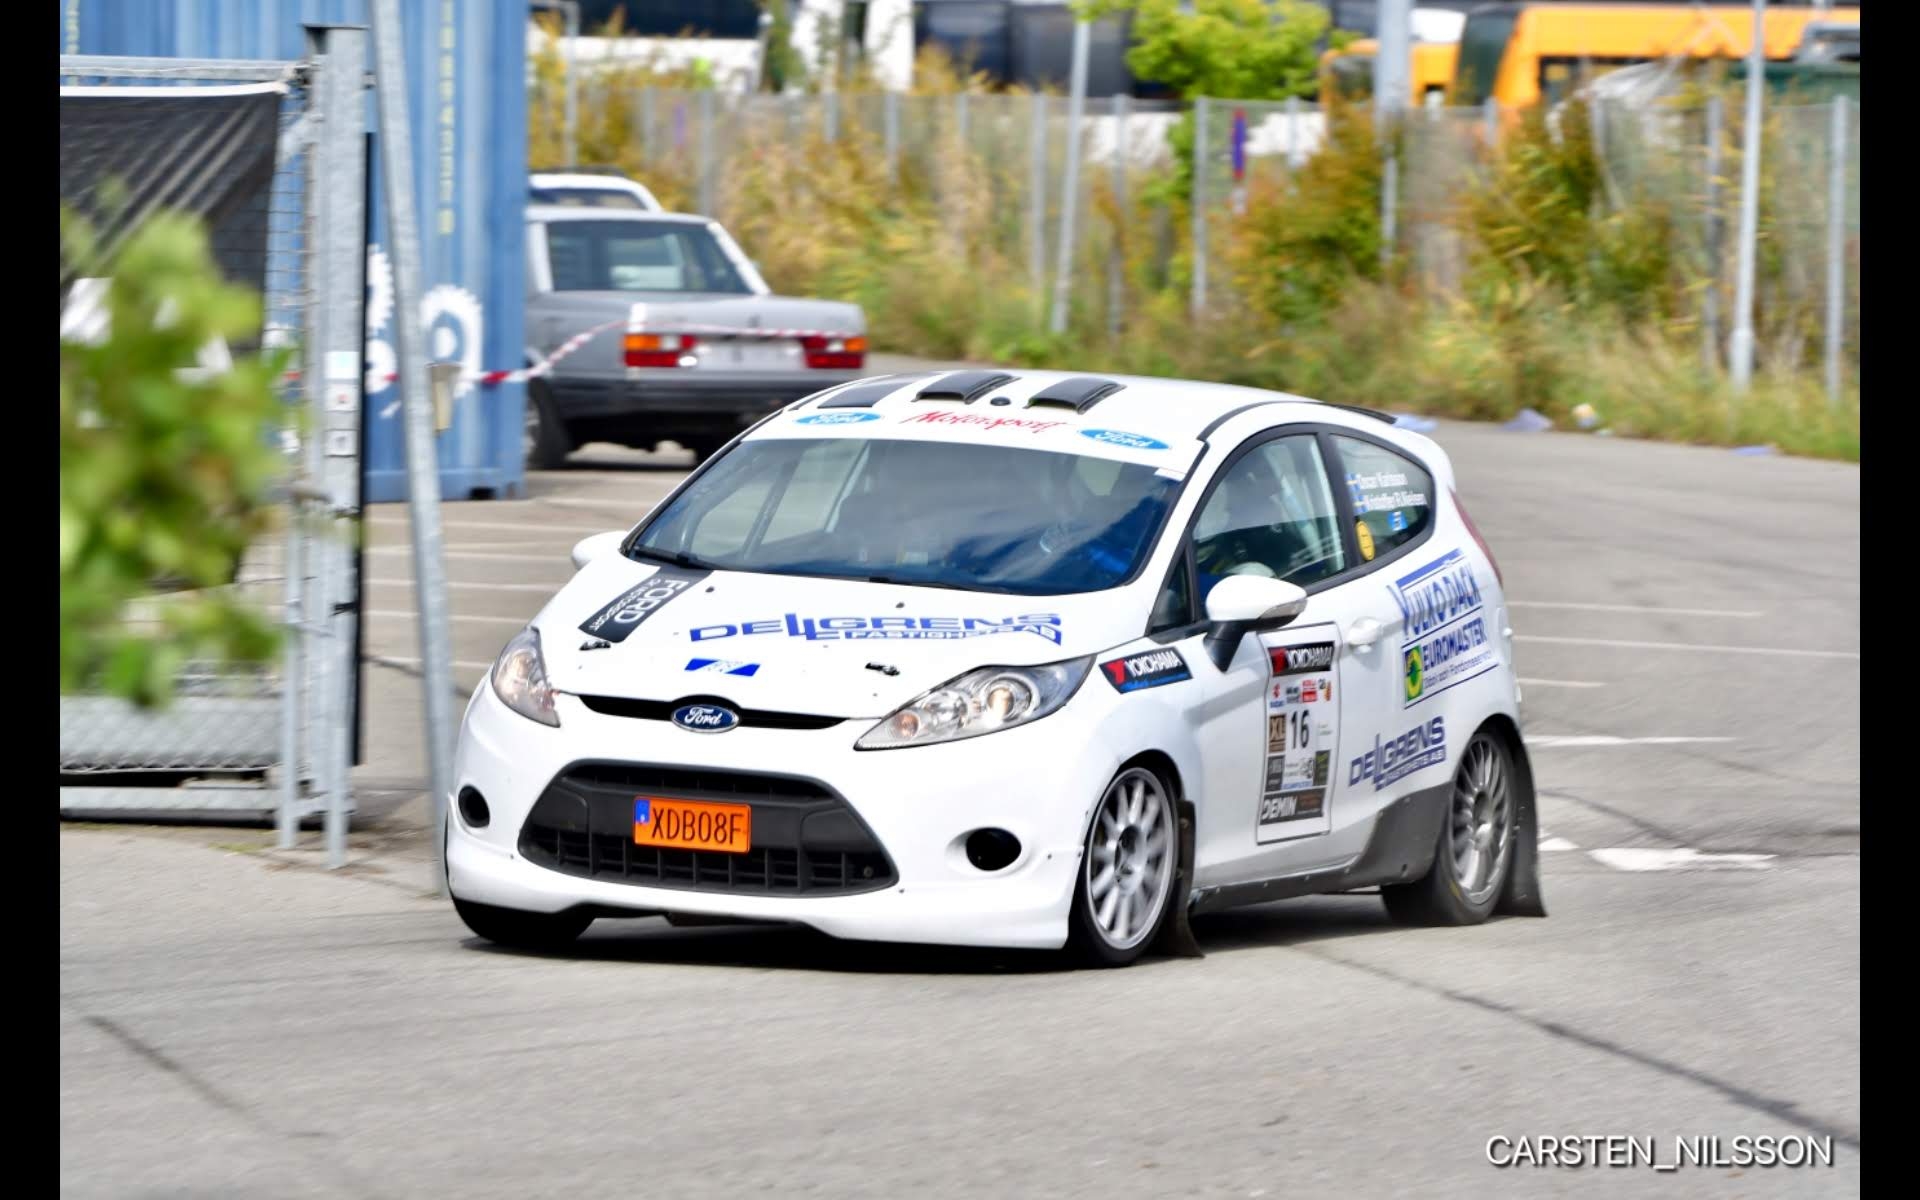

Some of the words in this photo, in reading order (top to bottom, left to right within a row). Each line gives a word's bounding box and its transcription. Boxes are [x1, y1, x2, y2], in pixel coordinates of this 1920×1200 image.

[898, 410, 1068, 434] Motorsport
[1092, 430, 1155, 448] Ford
[614, 579, 690, 624] FORD
[689, 613, 1061, 642] DELLGRENS
[1286, 646, 1333, 669] YOKOHAMA
[1422, 616, 1487, 672] EUROMASTER
[1124, 650, 1183, 677] YOKOHAMA
[684, 705, 722, 726] Ford
[1290, 708, 1310, 750] 16
[1348, 715, 1445, 788] DELLGRENS
[652, 807, 745, 846] XDB08F
